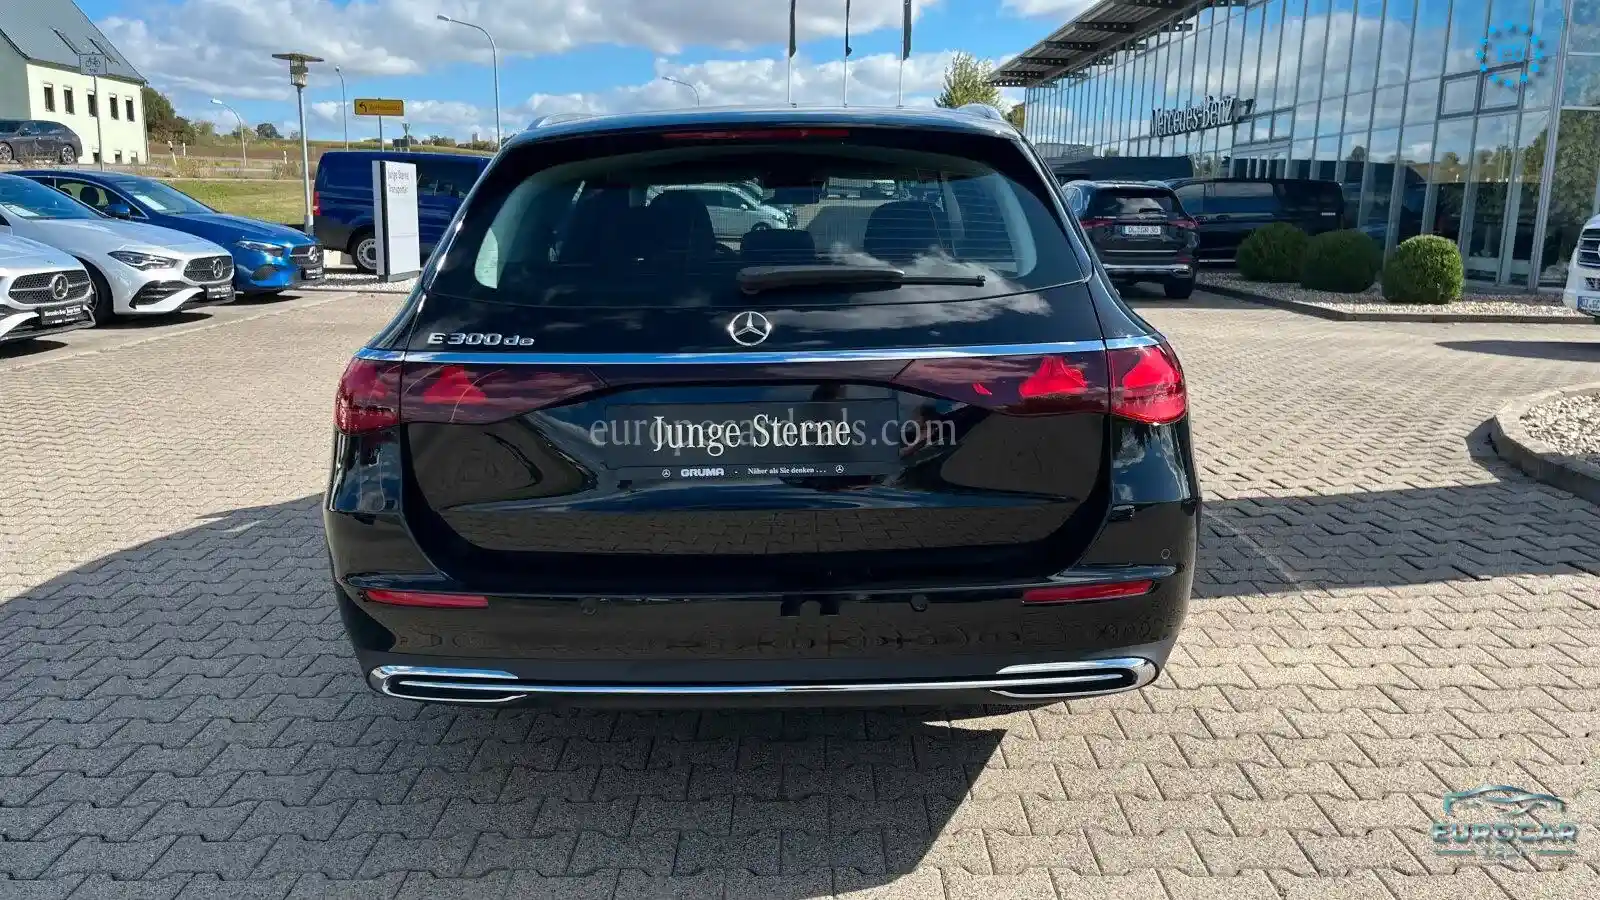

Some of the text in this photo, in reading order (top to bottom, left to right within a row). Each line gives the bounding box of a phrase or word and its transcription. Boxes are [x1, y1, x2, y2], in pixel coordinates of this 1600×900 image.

[1150, 95, 1234, 137] Mercedes-Benz
[653, 414, 851, 457] Junge Sterne
[680, 467, 725, 477] GRUMA
[747, 467, 768, 475] Näher
[769, 467, 779, 475] als
[779, 466, 790, 475] Sie
[791, 466, 815, 474] denken
